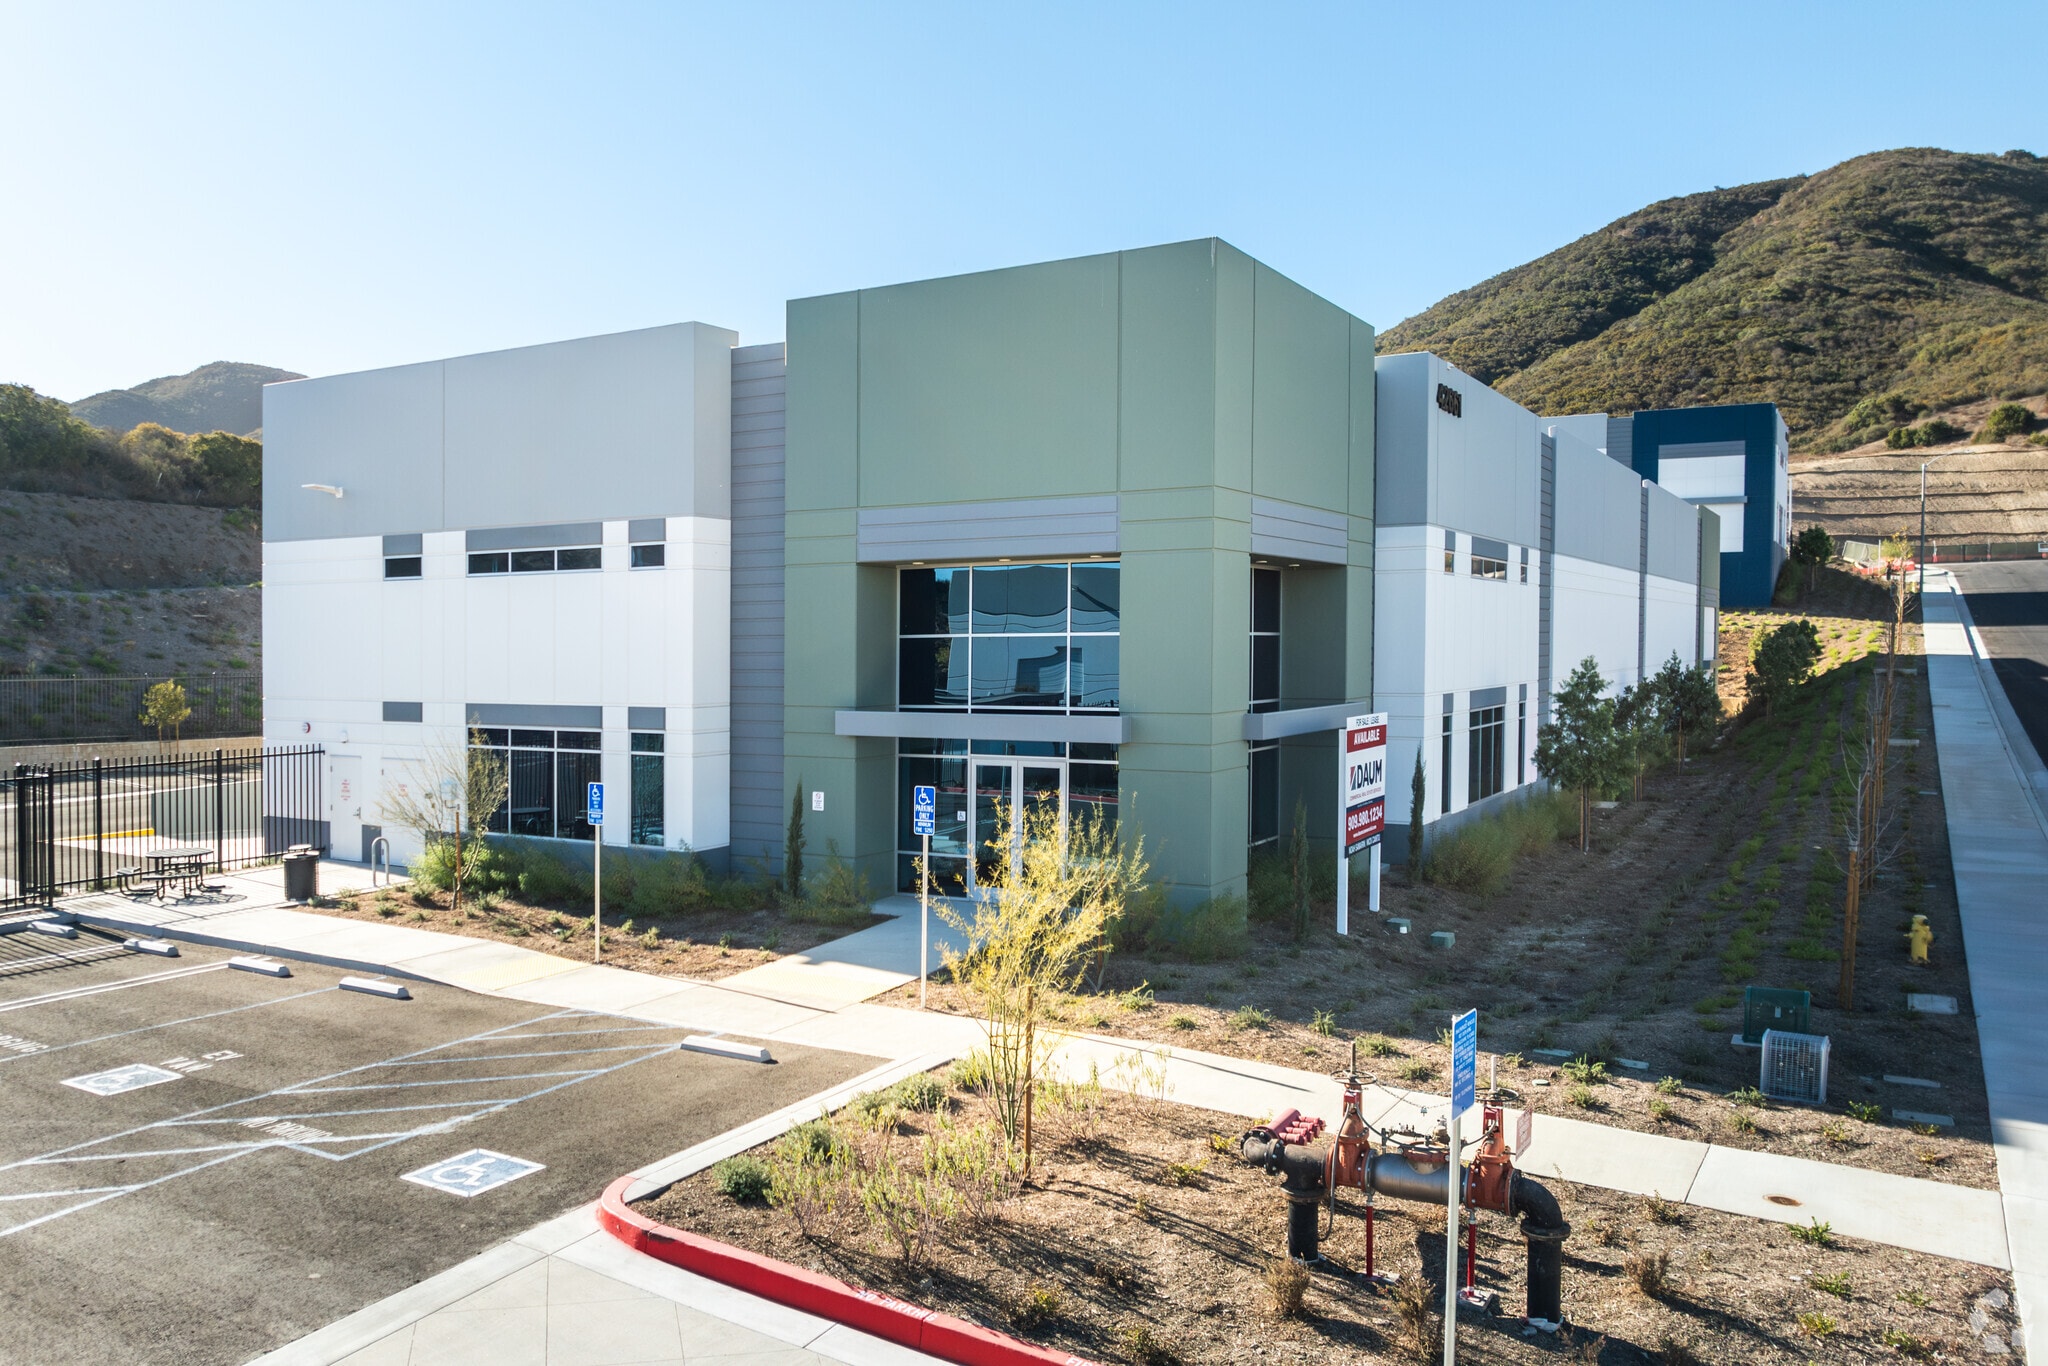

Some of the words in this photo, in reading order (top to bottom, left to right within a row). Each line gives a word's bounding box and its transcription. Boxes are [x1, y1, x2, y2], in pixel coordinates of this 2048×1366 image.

[1353, 729, 1380, 745] AVAILABLE
[1356, 759, 1382, 789] DAUM
[915, 804, 934, 812] PARKING
[919, 812, 930, 820] ONLY
[1348, 805, 1383, 831] 909.980.1234
[237, 1116, 279, 1128] NO
[260, 1121, 334, 1143] PARKING
[855, 1290, 877, 1302] NO
[879, 1298, 939, 1322] PARKING
